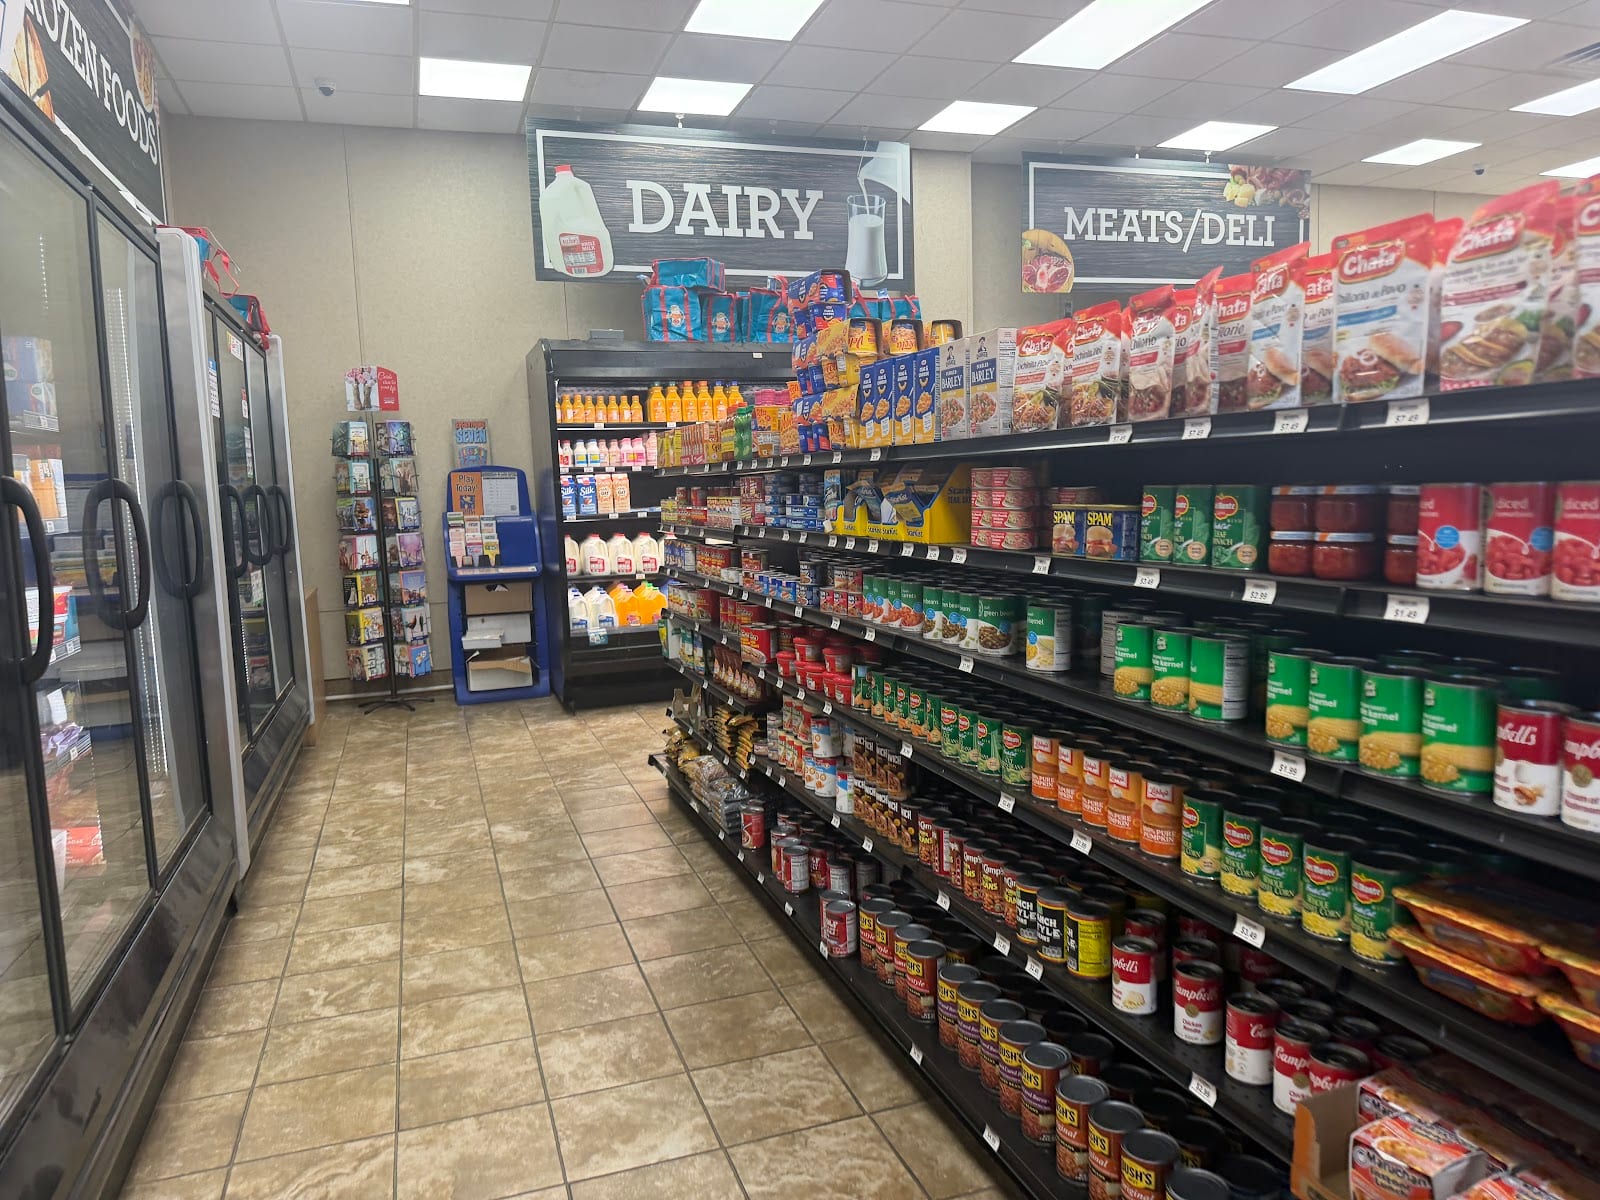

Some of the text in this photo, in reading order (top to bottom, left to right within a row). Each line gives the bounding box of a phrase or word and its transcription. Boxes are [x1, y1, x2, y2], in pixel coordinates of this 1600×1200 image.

[101, 57, 158, 165] FOODS
[626, 180, 823, 240] DAIRY
[1064, 207, 1275, 253] MEATS/DELI
[1344, 248, 1397, 276] Chata
[1022, 339, 1050, 353] Chata
[972, 368, 995, 383] BARLEY
[942, 375, 962, 389] BARLEY
[458, 475, 474, 484] Play
[580, 486, 595, 496] Silk
[1053, 510, 1075, 525] SPAM
[1087, 512, 1112, 526] SPAM
[1160, 660, 1184, 669] kernel
[1368, 710, 1399, 722] kernel
[1156, 829, 1176, 839] PURE
[1231, 830, 1250, 841] Monte
[1269, 847, 1289, 858] Monte
[1235, 868, 1255, 878] CORN
[1313, 866, 1335, 877] Monte
[1274, 886, 1295, 897] CORN
[1359, 884, 1380, 896] Monte
[1319, 908, 1341, 918] CORN
[1183, 1018, 1203, 1028] Chicken
[1367, 1151, 1428, 1186] Maruchan
